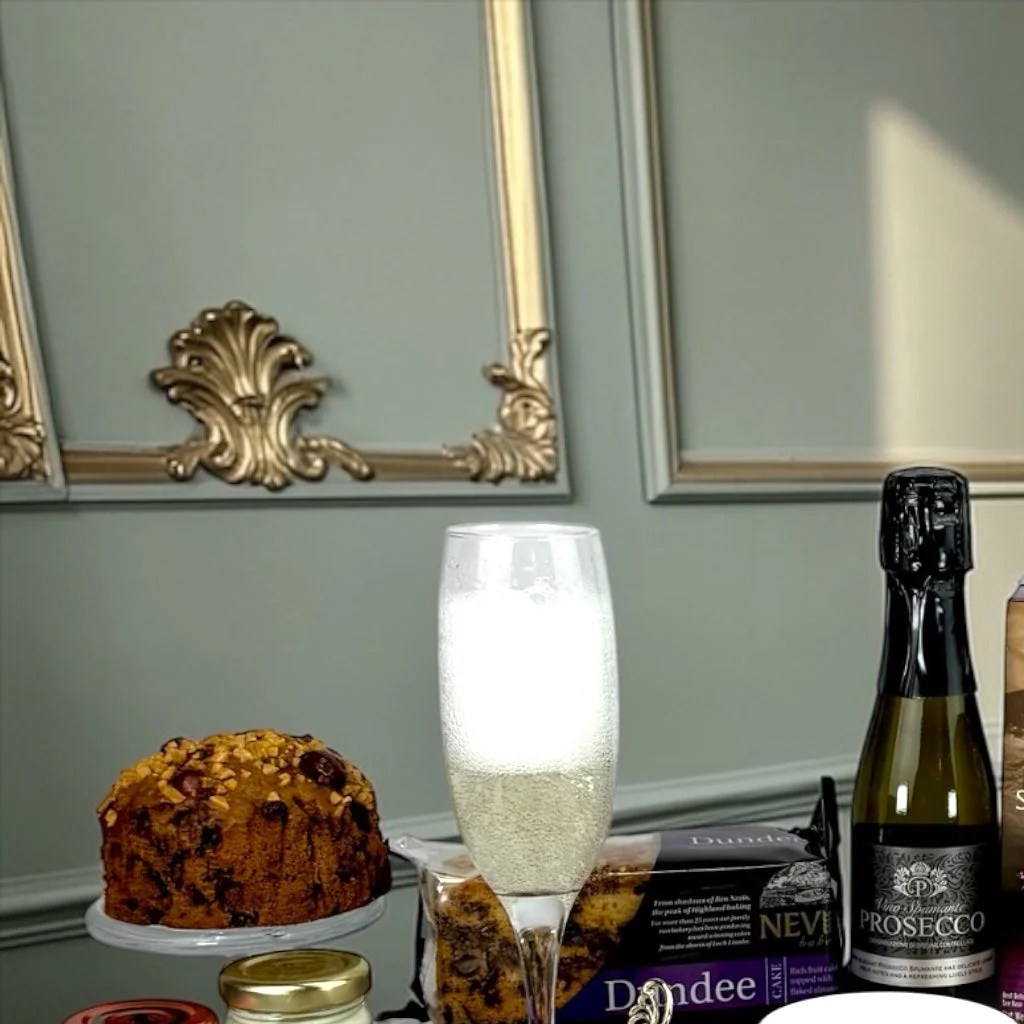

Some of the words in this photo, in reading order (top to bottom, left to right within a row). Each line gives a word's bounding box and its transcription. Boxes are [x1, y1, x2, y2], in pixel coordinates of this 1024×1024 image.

[860, 909, 985, 937] PROSECCO
[604, 971, 757, 1012] Dndee
[771, 963, 782, 999] CAKE
